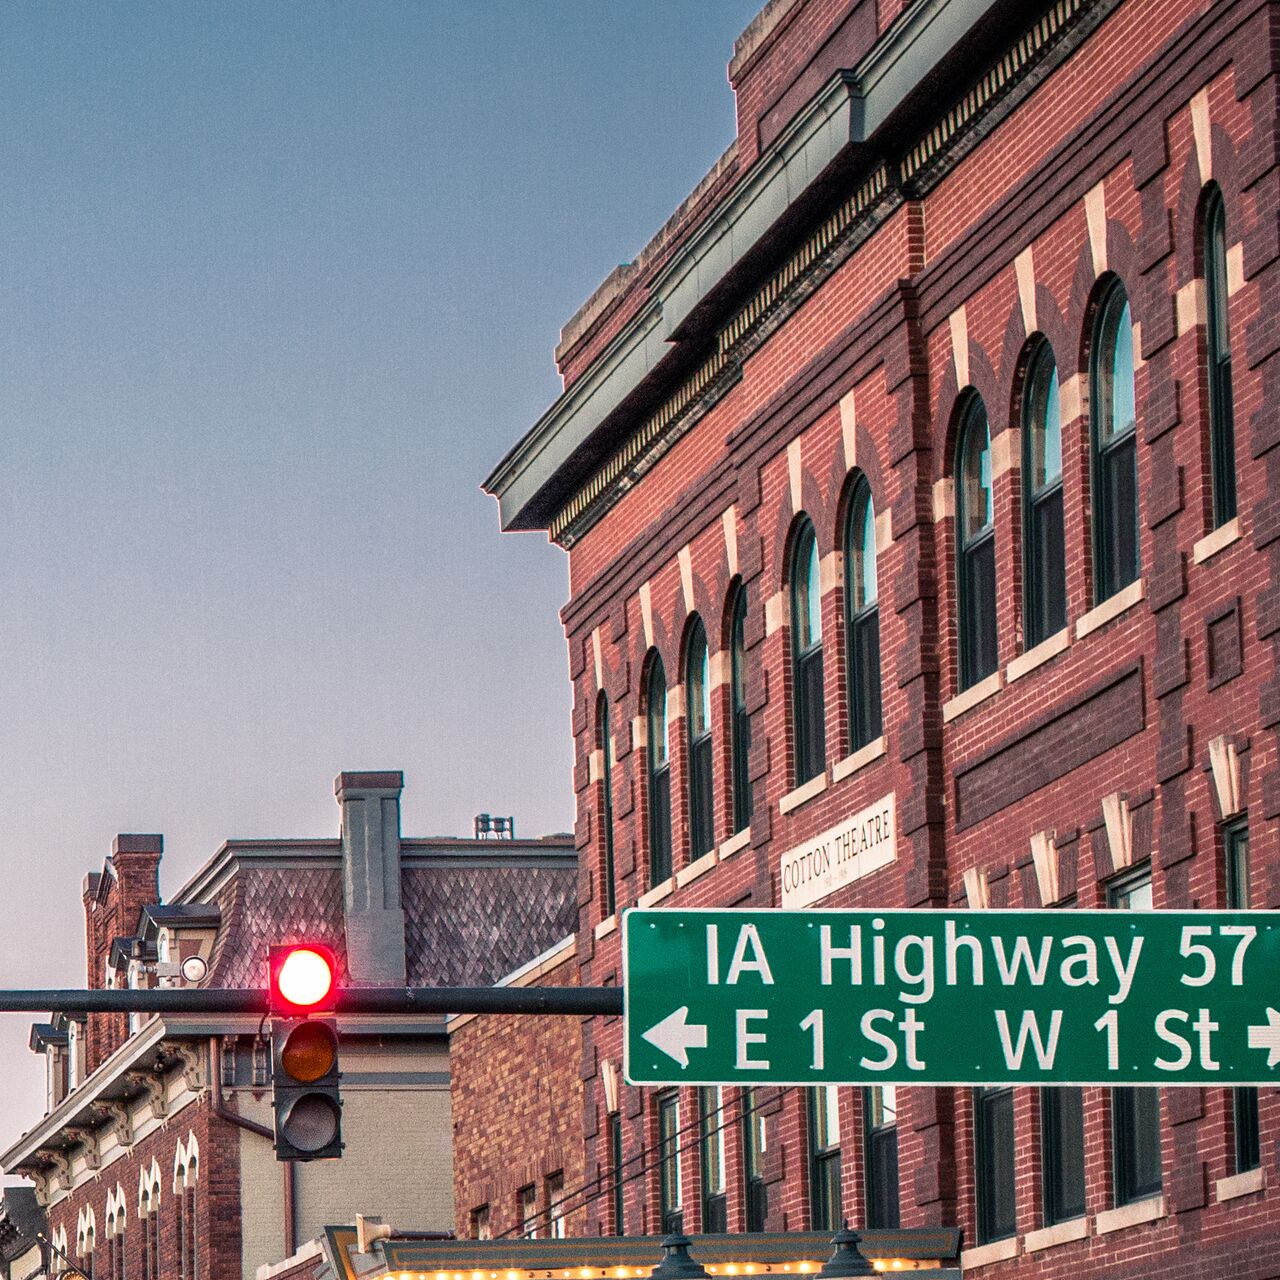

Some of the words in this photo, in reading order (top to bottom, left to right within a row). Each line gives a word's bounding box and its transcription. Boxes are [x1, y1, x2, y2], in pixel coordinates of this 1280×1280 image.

[784, 842, 830, 894] COTTON
[835, 809, 890, 865] THEATRE
[706, 924, 775, 985] IA
[819, 918, 1144, 1004] Highway
[1179, 925, 1257, 987] 57
[735, 1009, 770, 1070] E
[799, 1009, 824, 1070] 1
[859, 1008, 926, 1071] St
[994, 1009, 1064, 1070] W
[1093, 1009, 1119, 1070] 1
[1153, 1008, 1220, 1071] St
